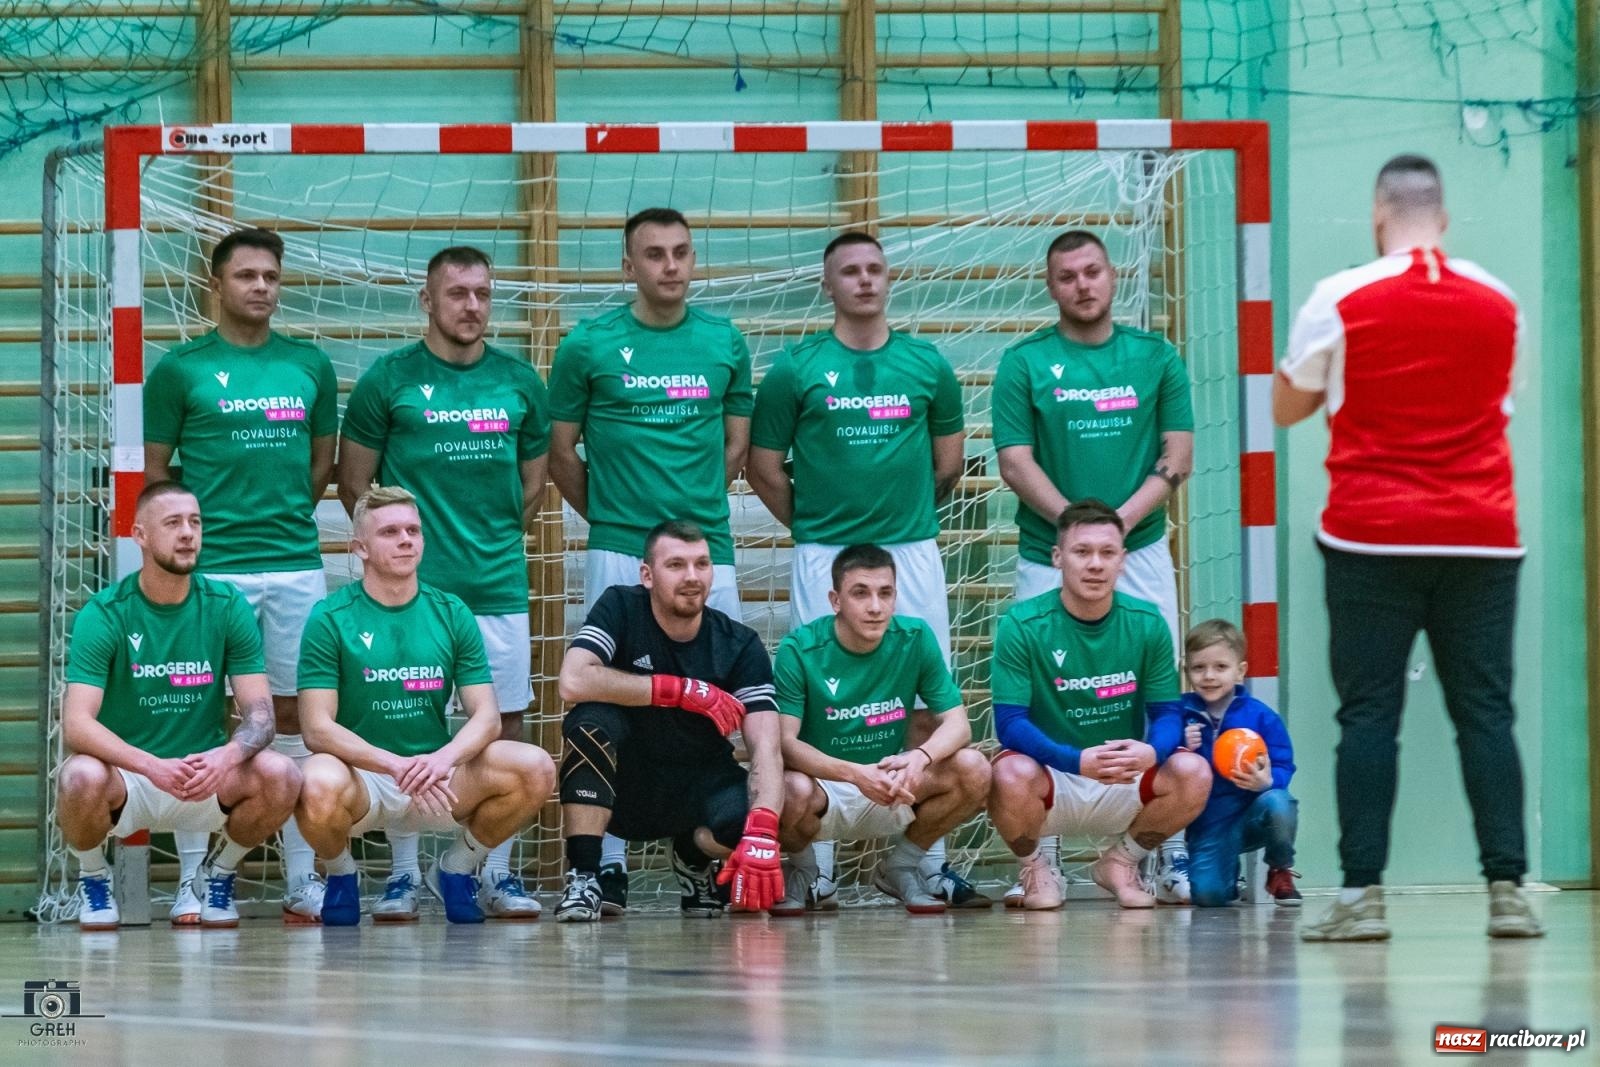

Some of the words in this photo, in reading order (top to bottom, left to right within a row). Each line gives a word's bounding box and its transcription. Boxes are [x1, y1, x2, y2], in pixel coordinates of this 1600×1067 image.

[222, 132, 266, 147] sport
[623, 374, 708, 388] DROGERIA
[1054, 385, 1136, 402] DROGERIA
[218, 396, 305, 413] DROGERIA
[826, 394, 910, 410] DROGERIA
[424, 408, 508, 424] DROGERIA
[132, 660, 212, 678] DROGERIA
[364, 666, 444, 682] DROGERIA
[1054, 670, 1136, 692] DROGERIA
[825, 696, 904, 720] DROGERIA
